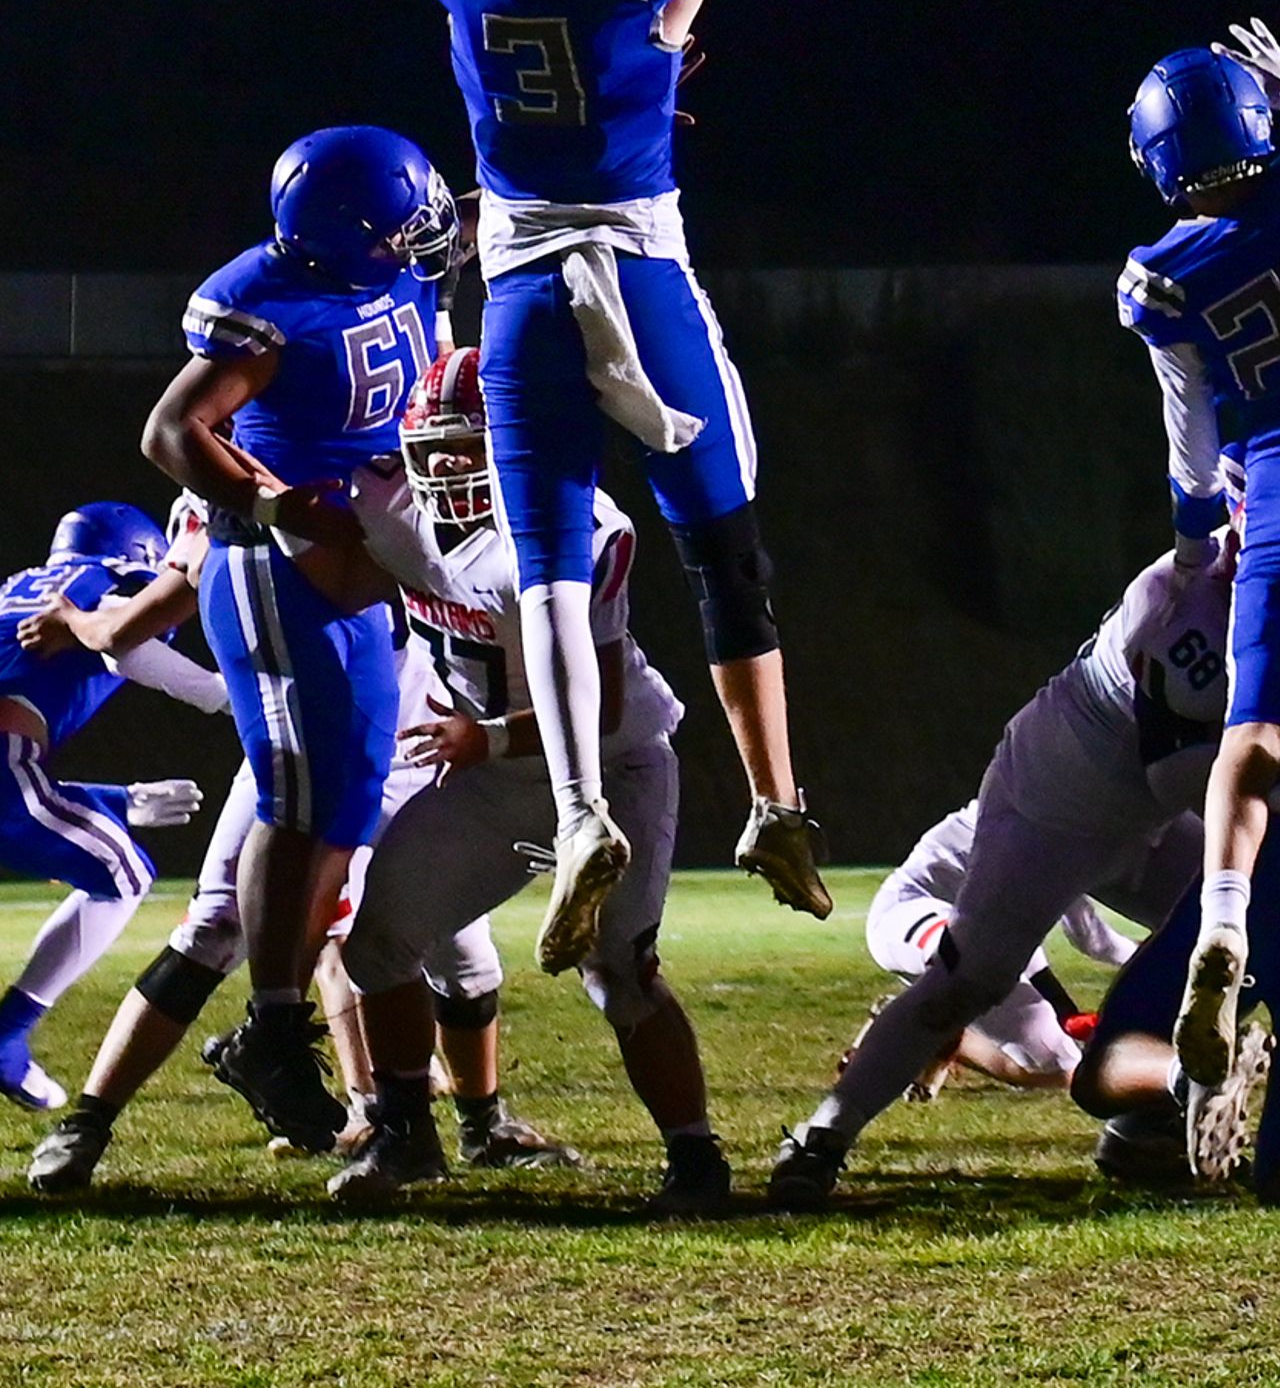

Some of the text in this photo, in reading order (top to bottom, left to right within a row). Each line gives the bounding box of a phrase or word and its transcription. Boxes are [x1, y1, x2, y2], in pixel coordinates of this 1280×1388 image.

[482, 12, 587, 128] 3
[341, 301, 433, 433] 61
[1169, 628, 1222, 691] 68
